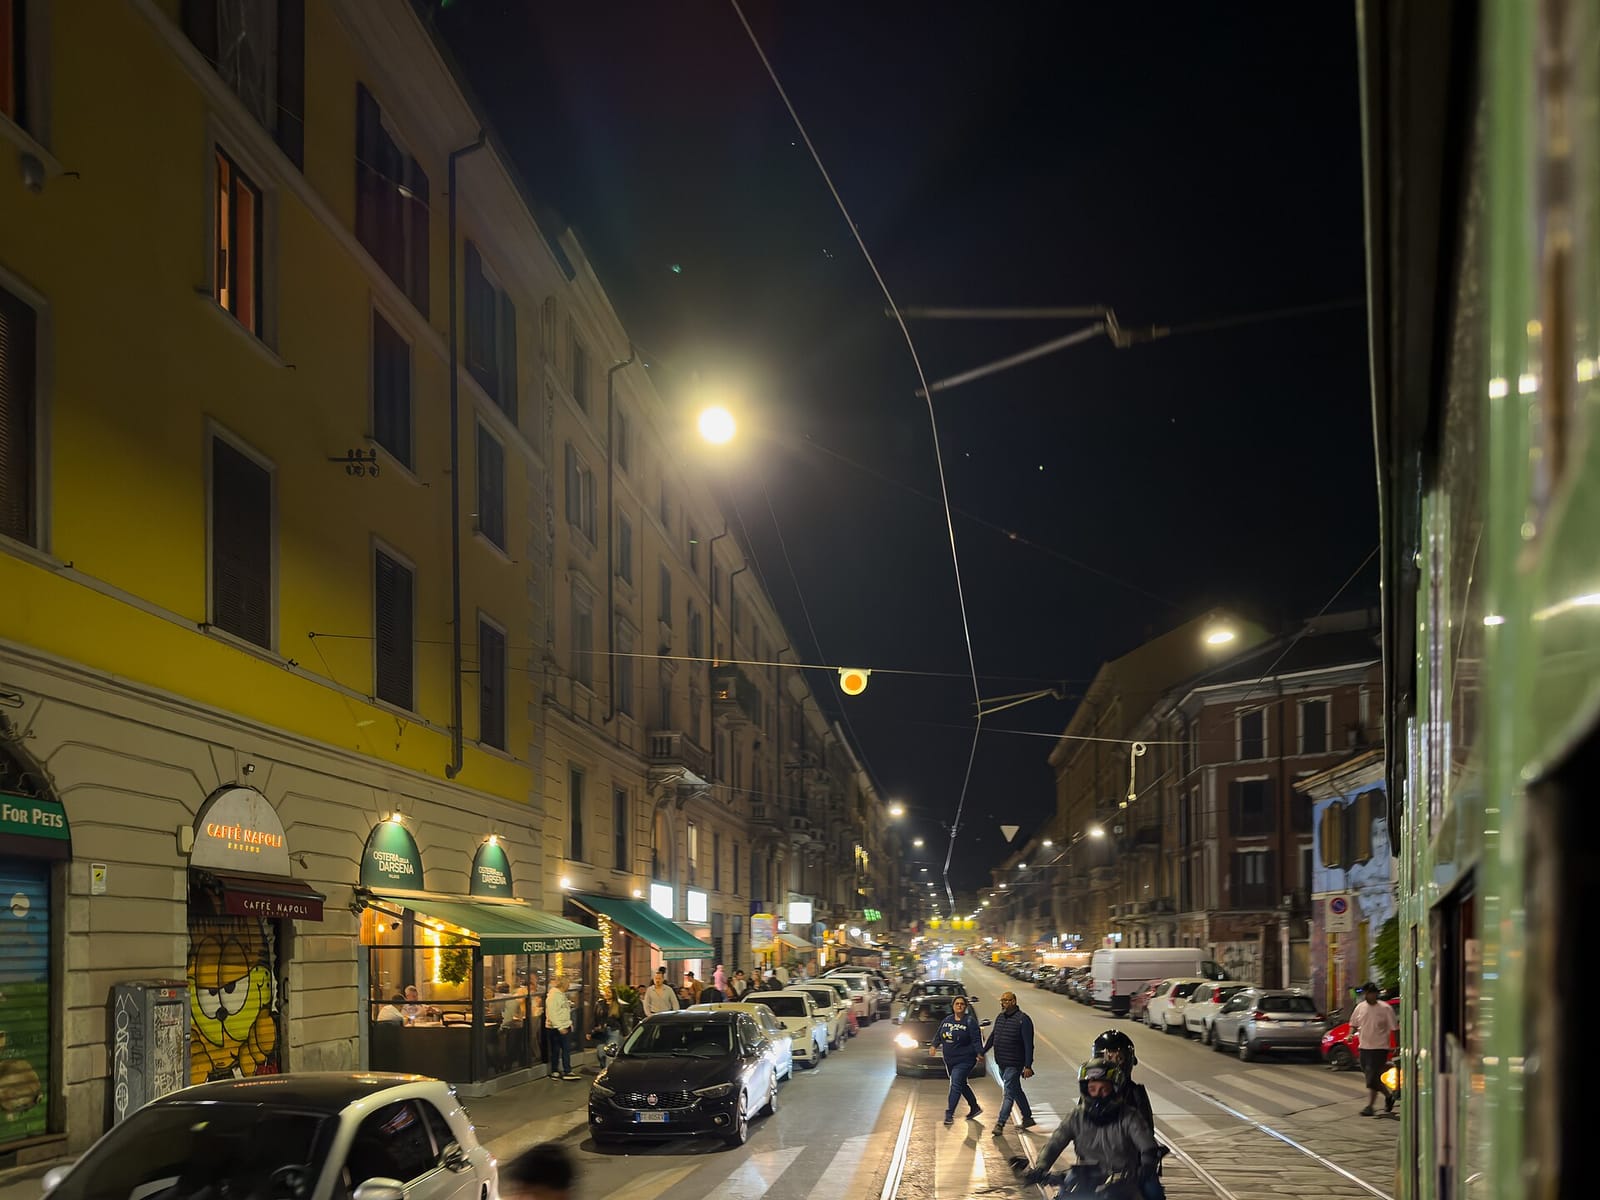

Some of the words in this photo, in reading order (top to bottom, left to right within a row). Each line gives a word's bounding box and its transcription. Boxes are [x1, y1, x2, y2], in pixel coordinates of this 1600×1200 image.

[207, 823, 242, 841] CAFFÈ
[244, 829, 282, 848] NAPOLI
[373, 851, 399, 862] OSTERIA
[378, 860, 414, 875] DARSENA
[482, 873, 507, 885] DARSENA
[277, 903, 308, 914] NAPOLI
[523, 941, 546, 952] OSTERIA
[554, 939, 580, 951] DARSENA
